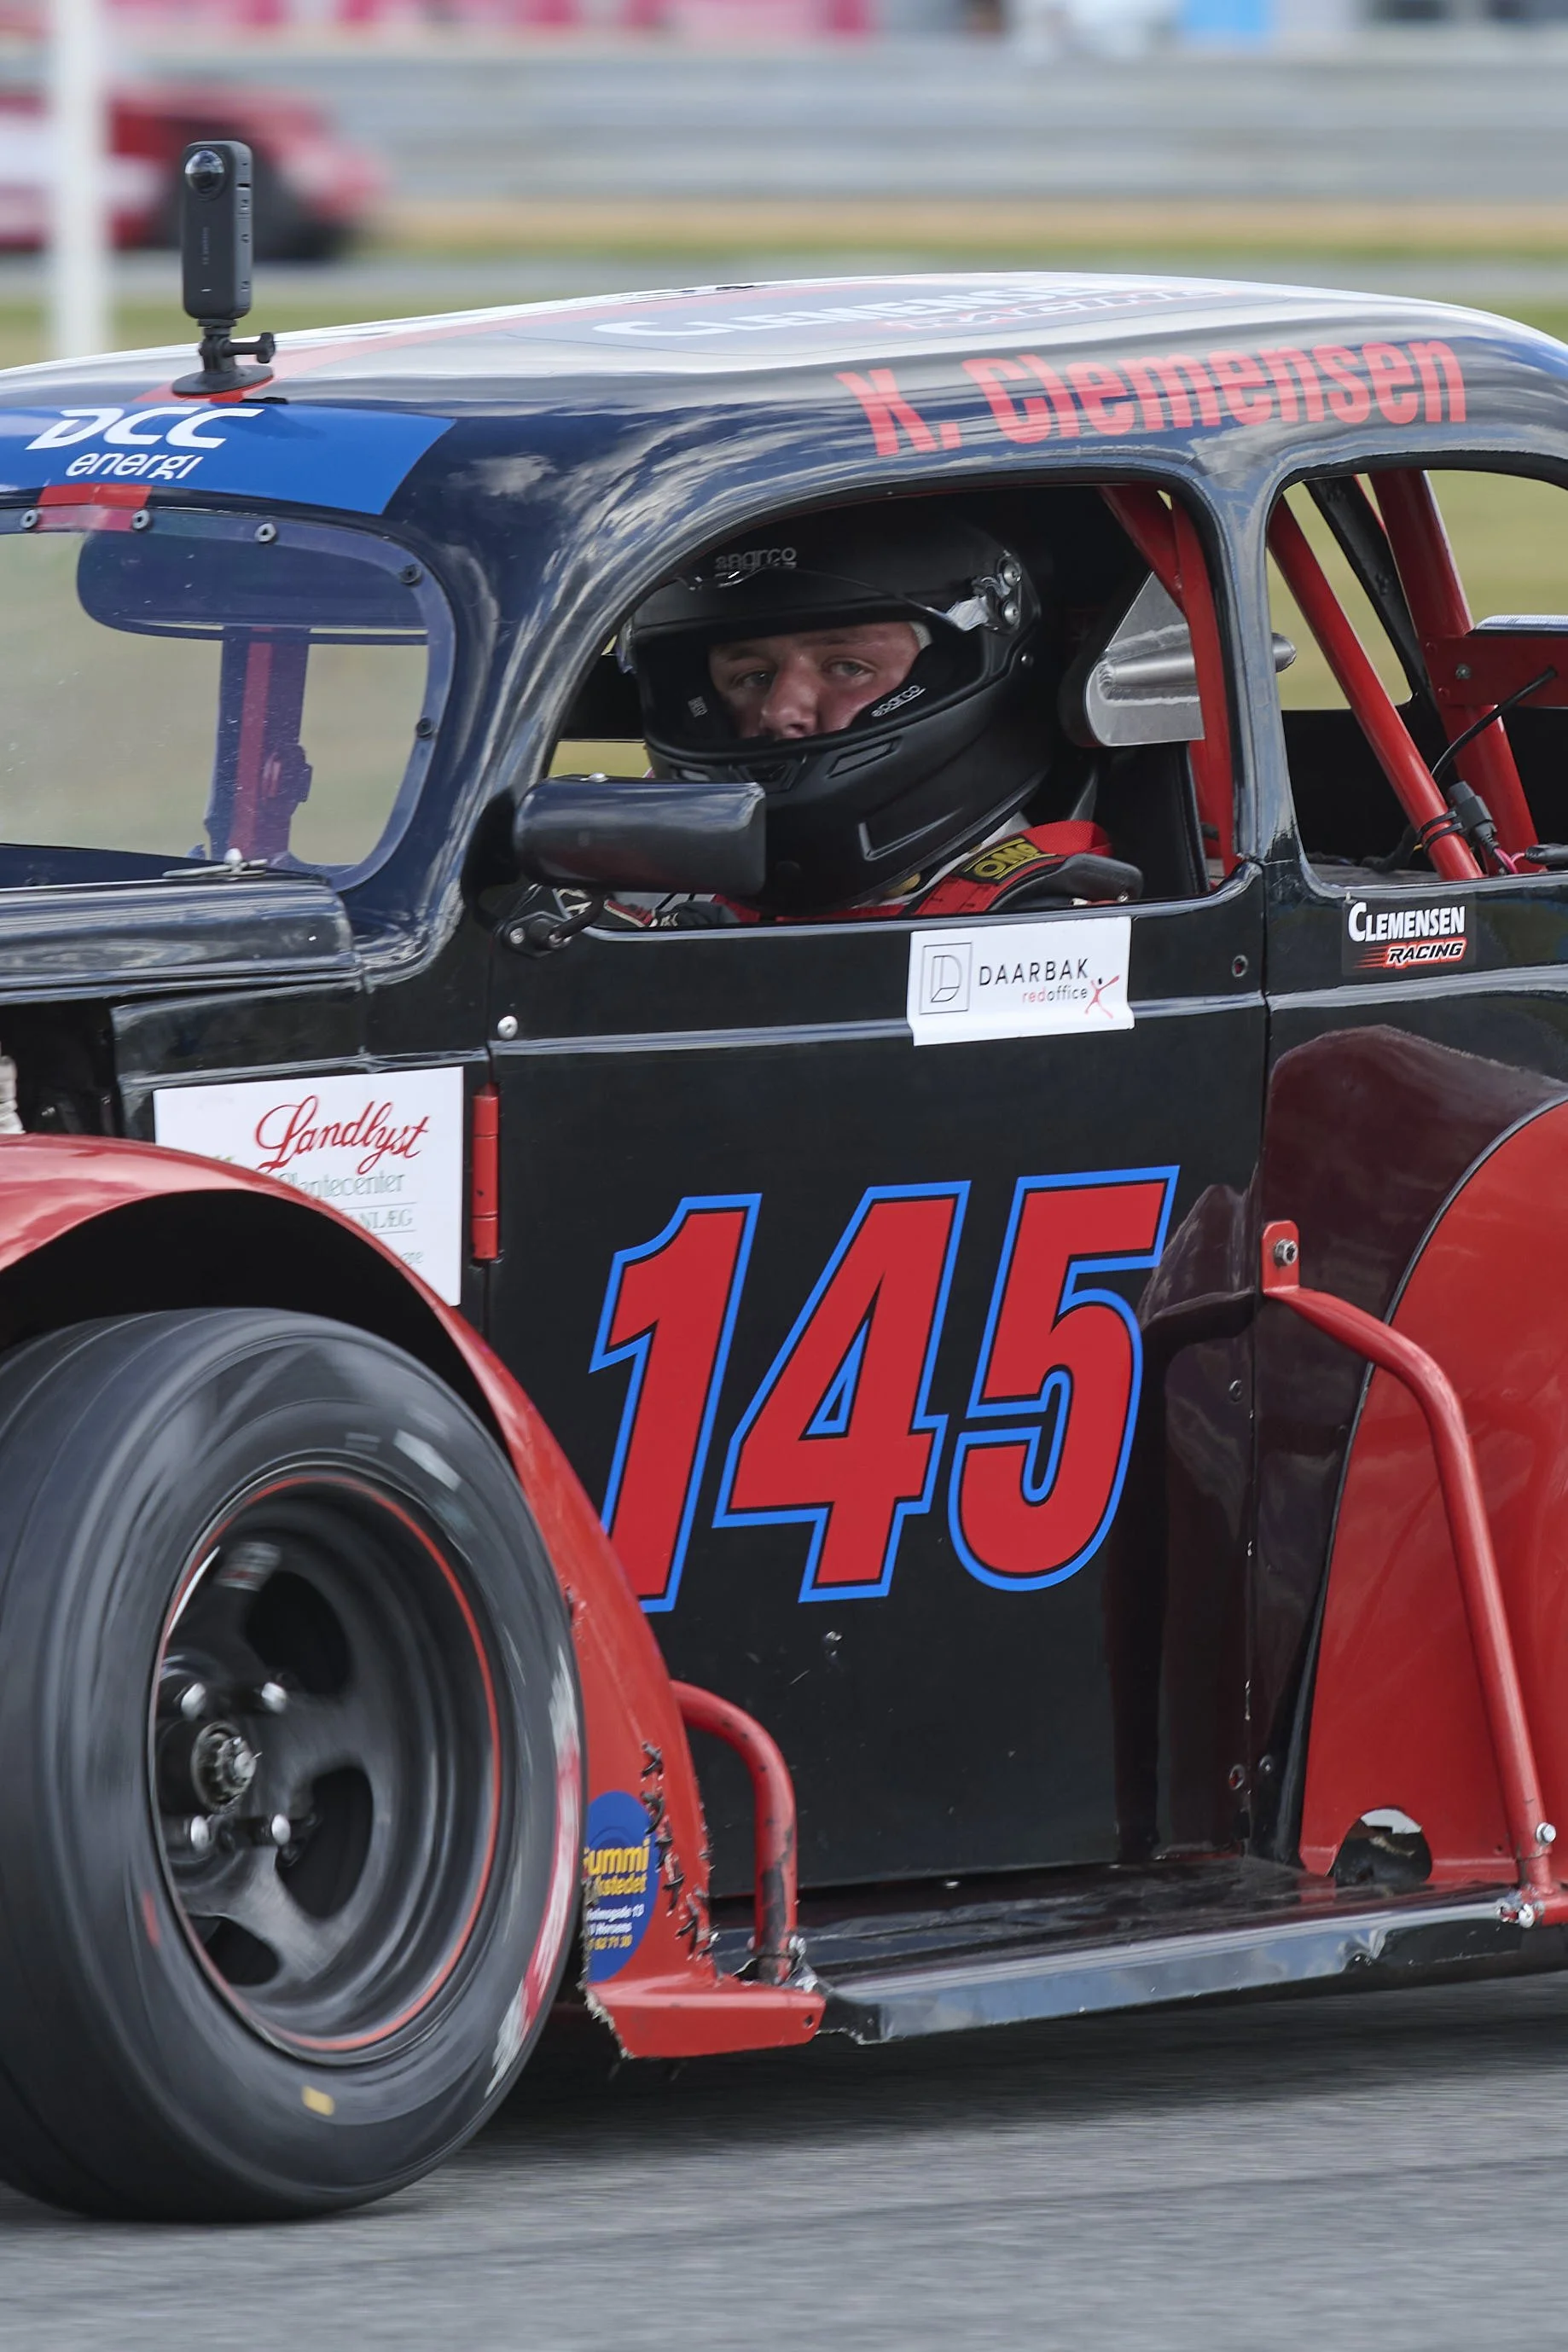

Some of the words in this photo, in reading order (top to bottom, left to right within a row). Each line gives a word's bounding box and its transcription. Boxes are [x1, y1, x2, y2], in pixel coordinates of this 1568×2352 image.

[592, 285, 1167, 336] CLEMENSE
[961, 340, 1466, 444] Clemensen
[25, 407, 264, 450] DCC
[871, 685, 924, 717] sparco
[973, 843, 1040, 878] OMP
[1348, 902, 1466, 942] CLEMENSEN
[979, 958, 1089, 986] DAARBAK
[1388, 942, 1464, 964] RACING
[1023, 986, 1088, 1003] redoffice
[254, 1095, 431, 1175] Landlyst
[589, 1165, 1180, 1612] 145
[584, 1836, 650, 1876] ummi
